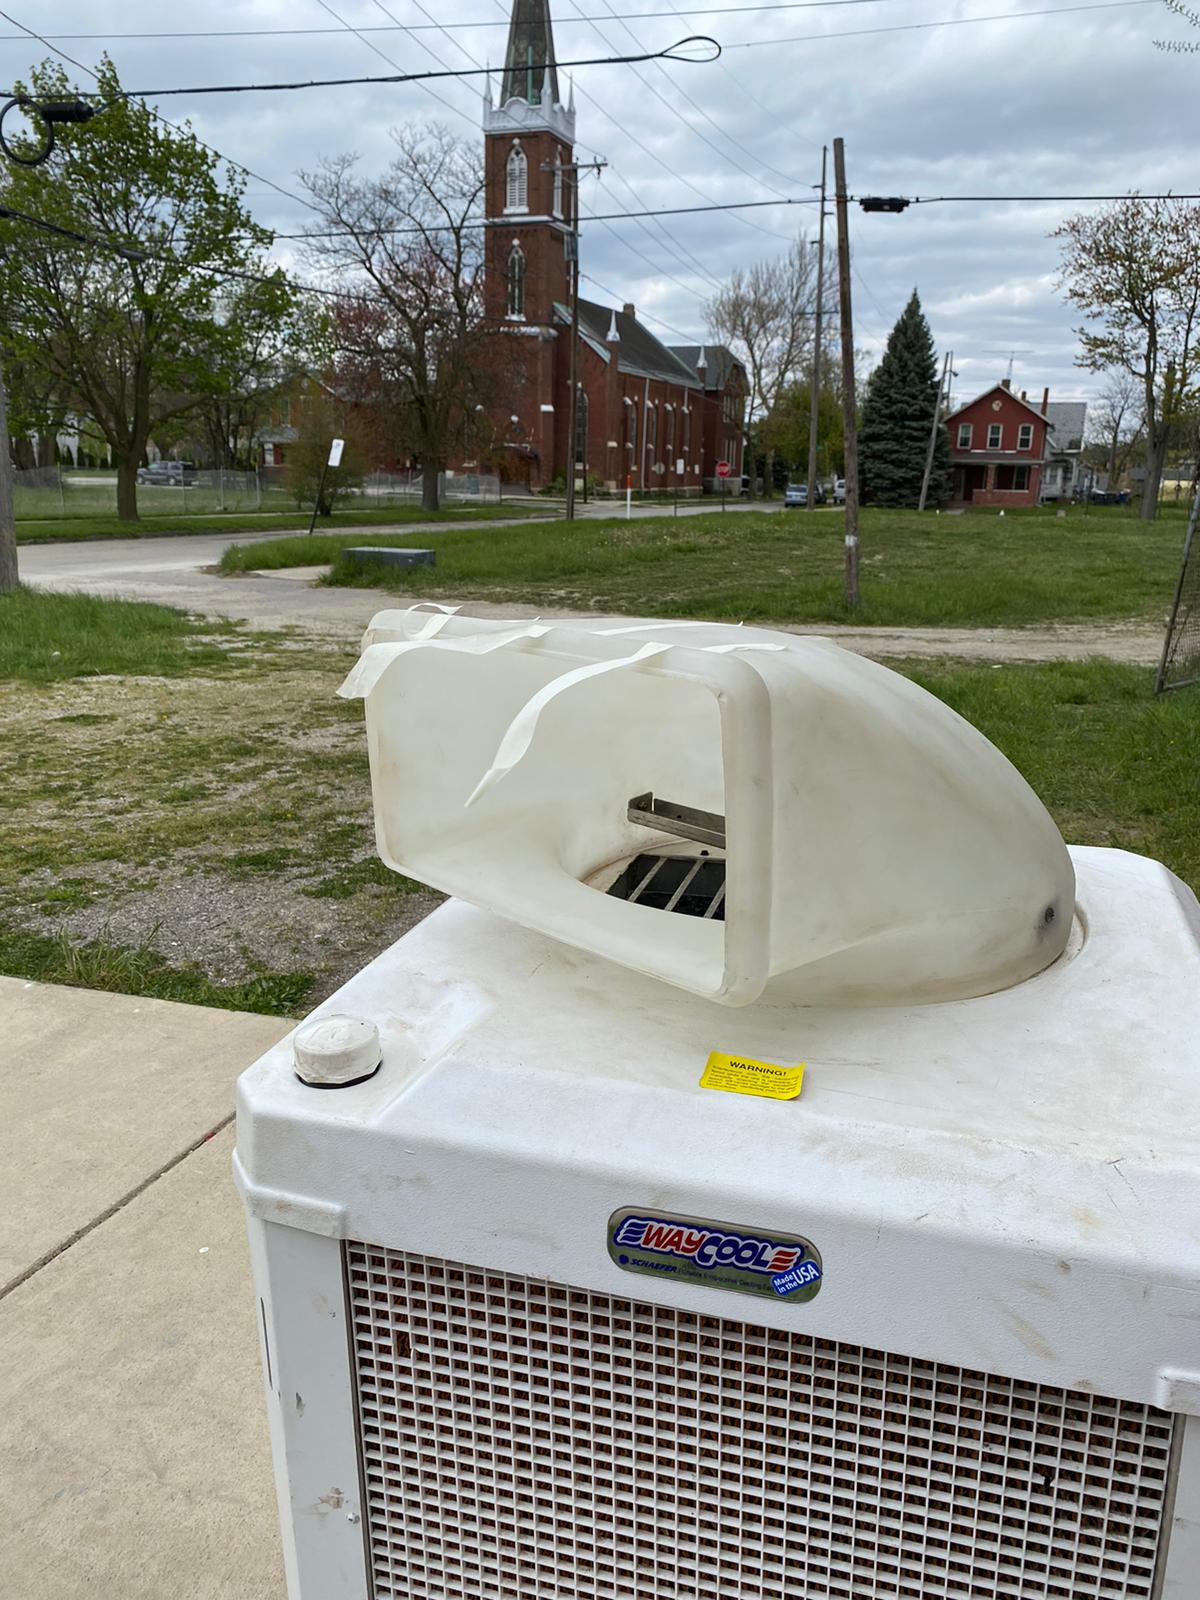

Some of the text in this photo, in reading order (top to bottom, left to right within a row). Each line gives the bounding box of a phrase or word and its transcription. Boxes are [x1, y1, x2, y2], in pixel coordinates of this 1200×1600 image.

[729, 1060, 787, 1077] WARNING!
[630, 1258, 677, 1273] SCHAEFER
[773, 1274, 794, 1287] Made
[791, 1264, 819, 1284] USA
[777, 1286, 787, 1294] in
[785, 1281, 798, 1290] the
